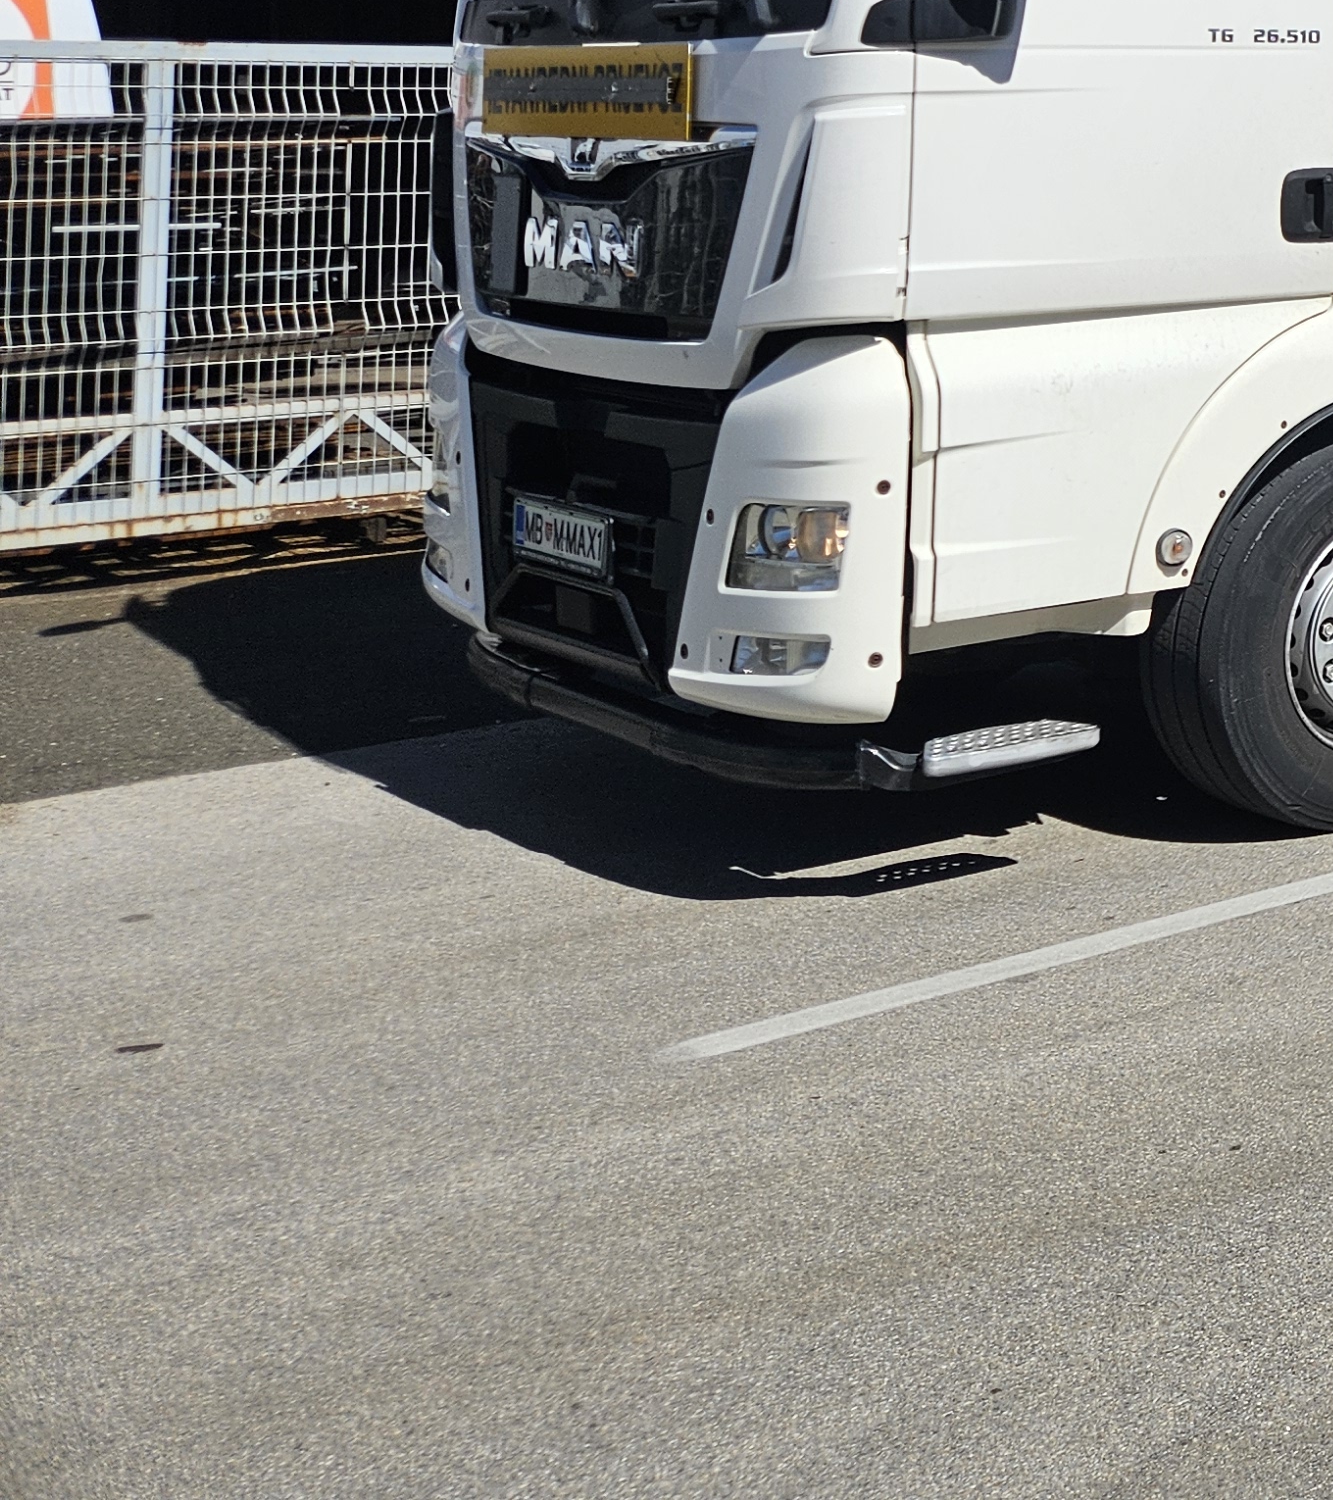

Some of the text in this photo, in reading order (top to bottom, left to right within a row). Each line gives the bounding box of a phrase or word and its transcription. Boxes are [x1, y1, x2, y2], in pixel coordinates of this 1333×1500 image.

[1207, 28, 1321, 44] TG 26.510
[523, 216, 645, 281] MAN
[525, 510, 544, 545] MB
